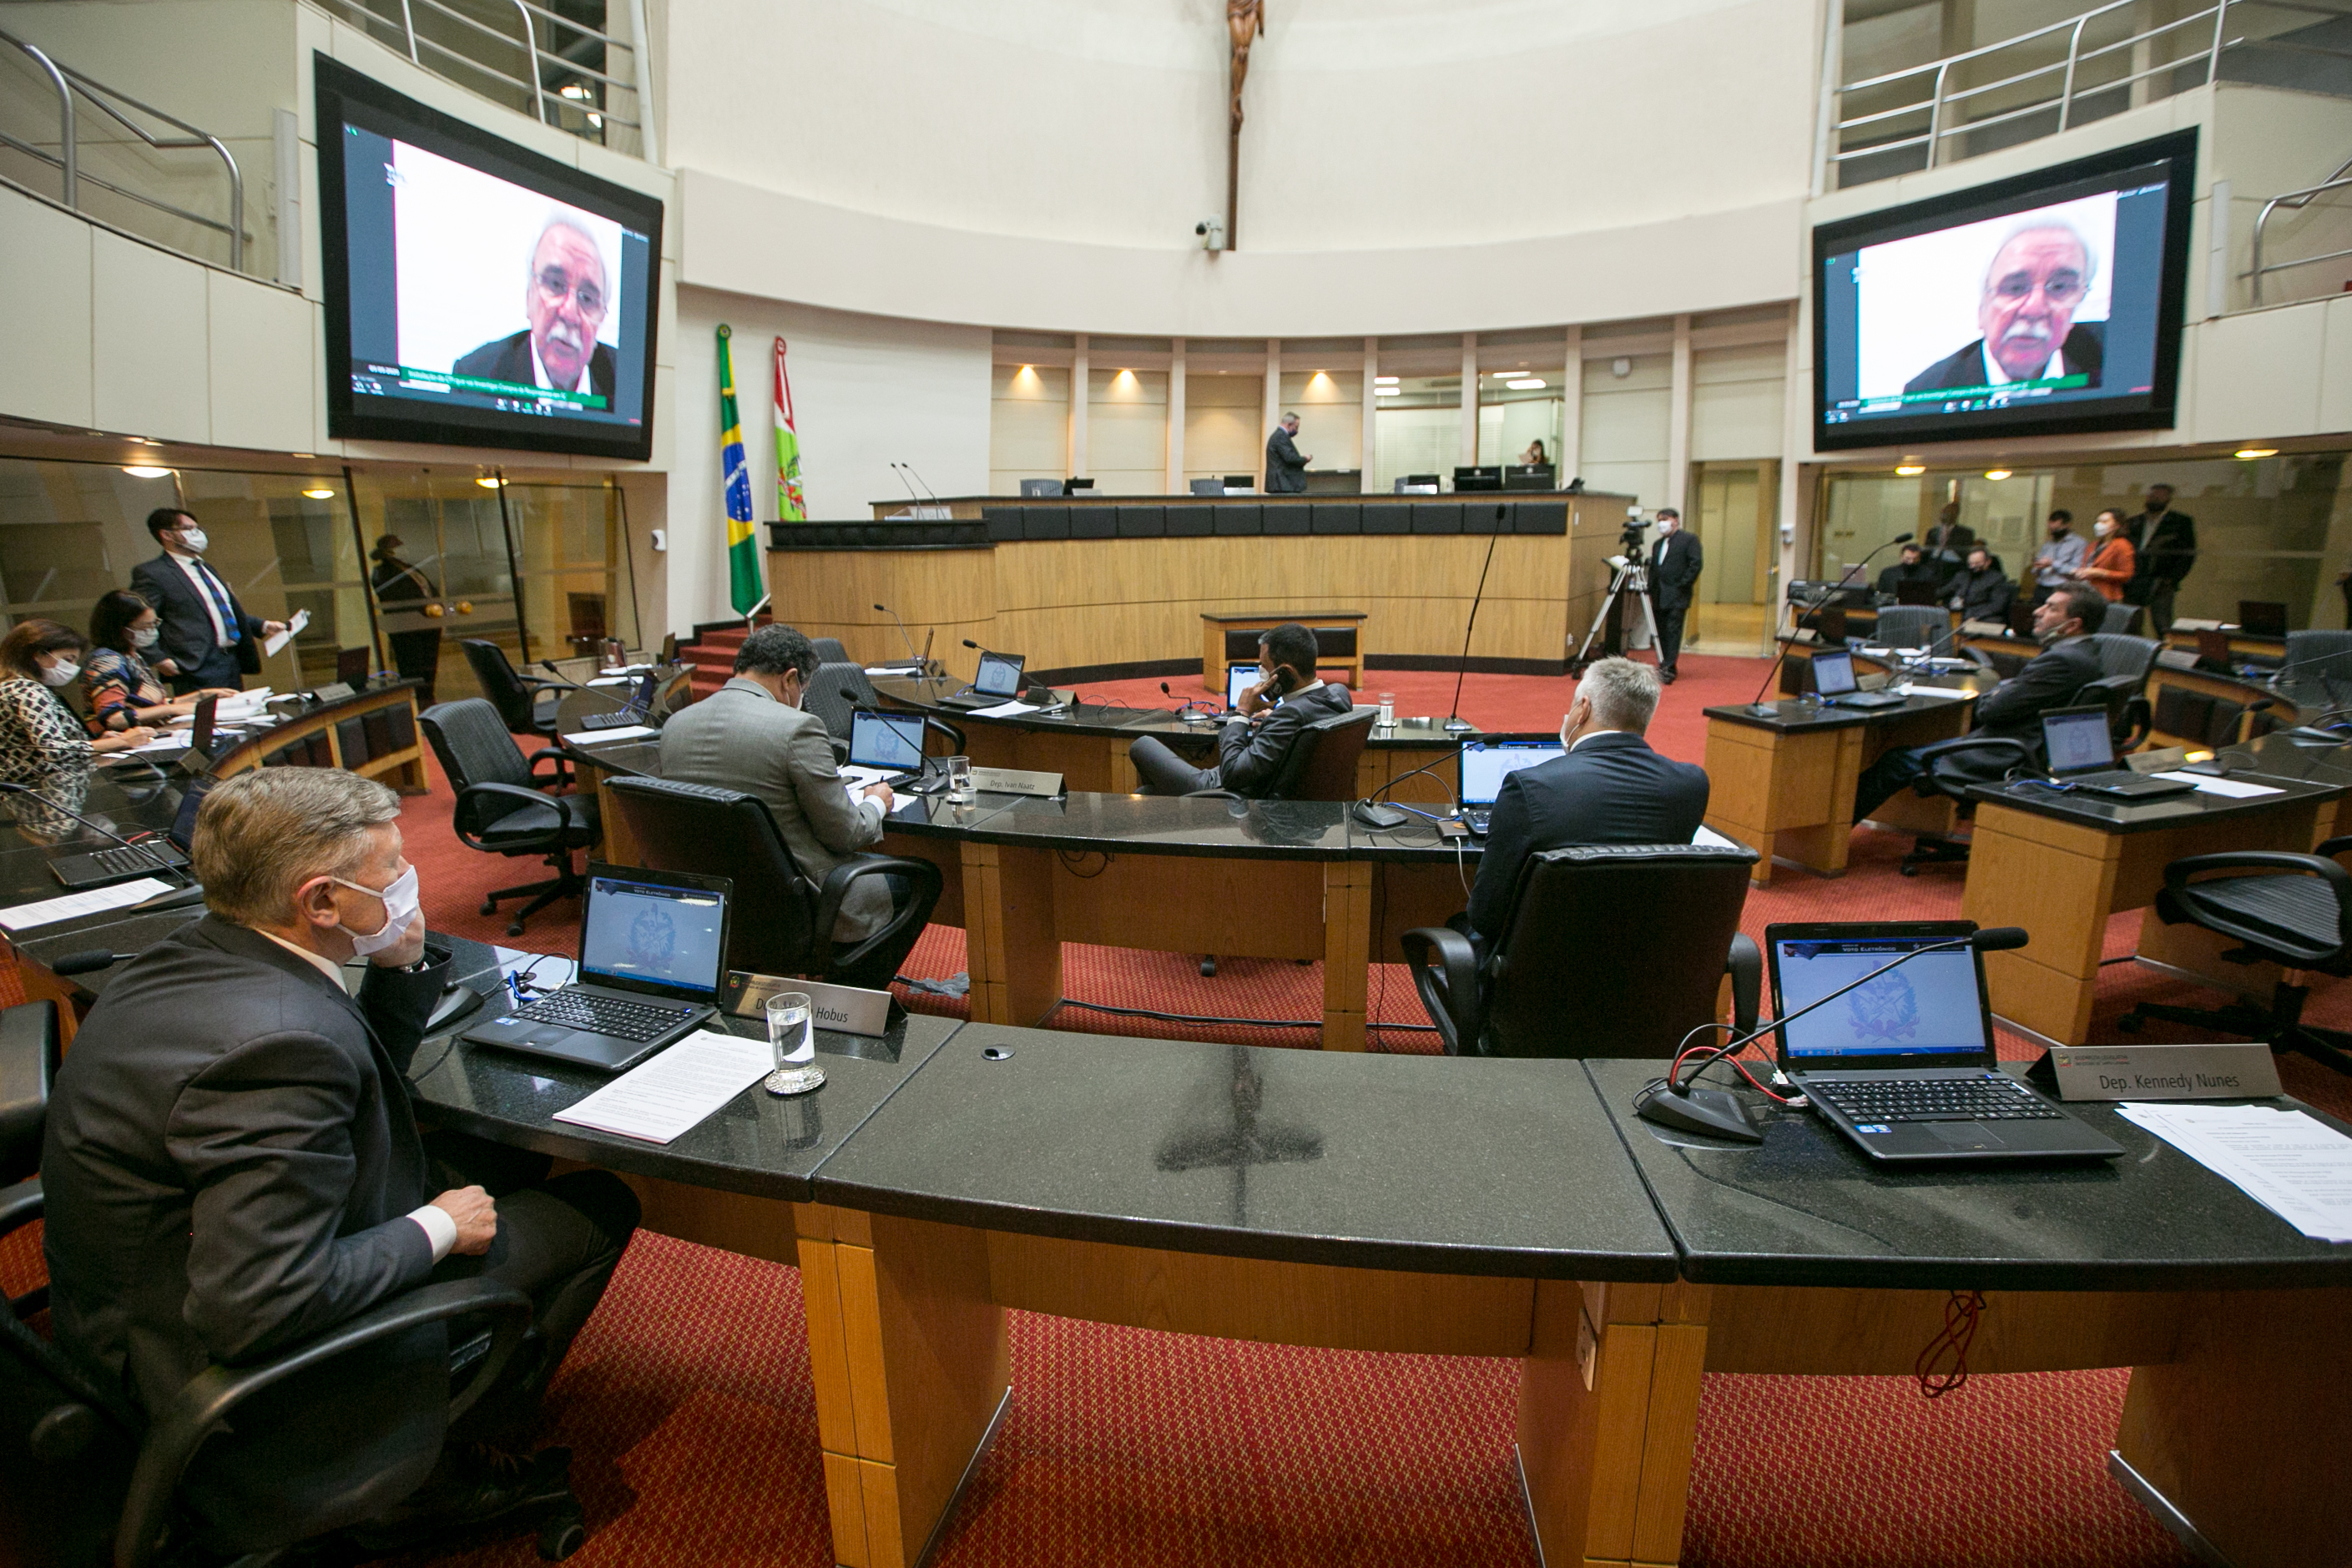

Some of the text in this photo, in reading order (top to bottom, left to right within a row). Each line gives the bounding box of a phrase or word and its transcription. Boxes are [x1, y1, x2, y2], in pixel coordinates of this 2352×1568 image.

[991, 780, 1002, 789] Dep.
[815, 1007, 848, 1023] Hobus
[2099, 1073, 2240, 1093] Dep. Kennedy Nunes
